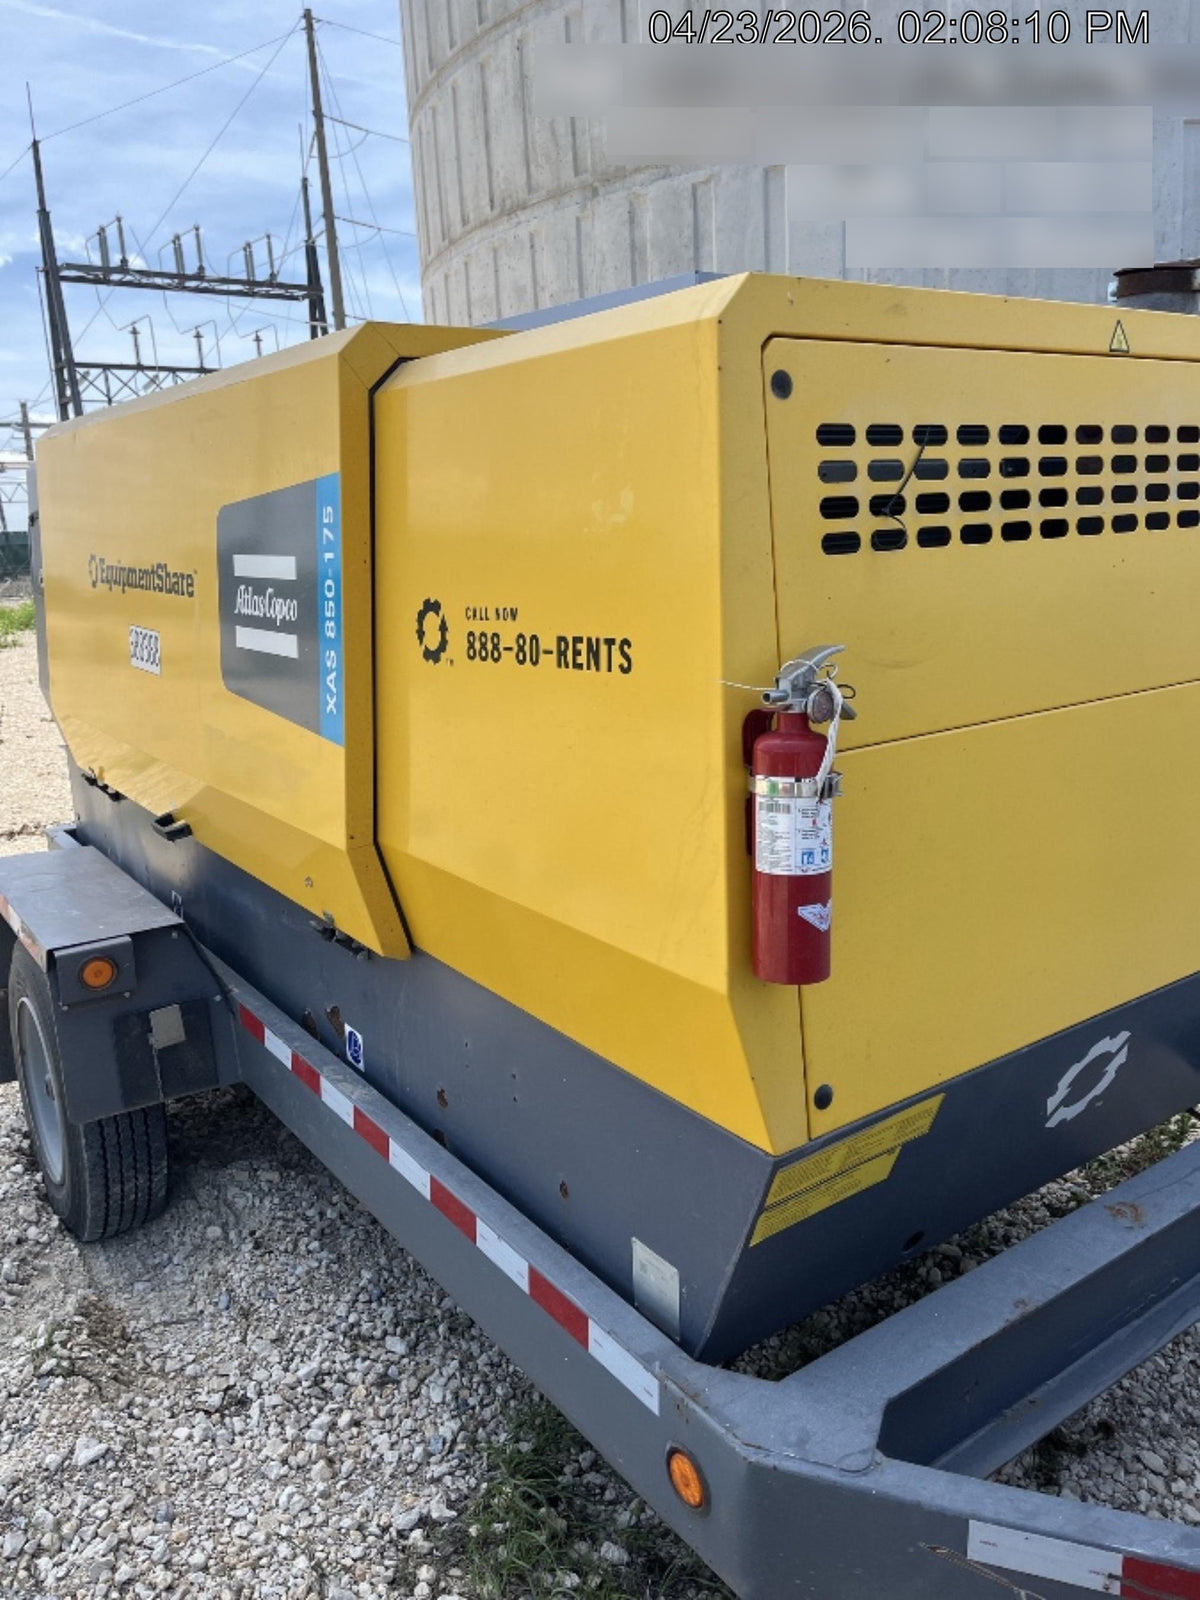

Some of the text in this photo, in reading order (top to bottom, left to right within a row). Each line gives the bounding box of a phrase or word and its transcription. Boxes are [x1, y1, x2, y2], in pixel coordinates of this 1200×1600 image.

[98, 557, 195, 598] EquipmentShare
[234, 585, 298, 627] Atlas Copco
[323, 506, 337, 715] XAS 850-175
[465, 606, 519, 622] CALL NOW
[466, 630, 632, 675] 888-80-RENTS
